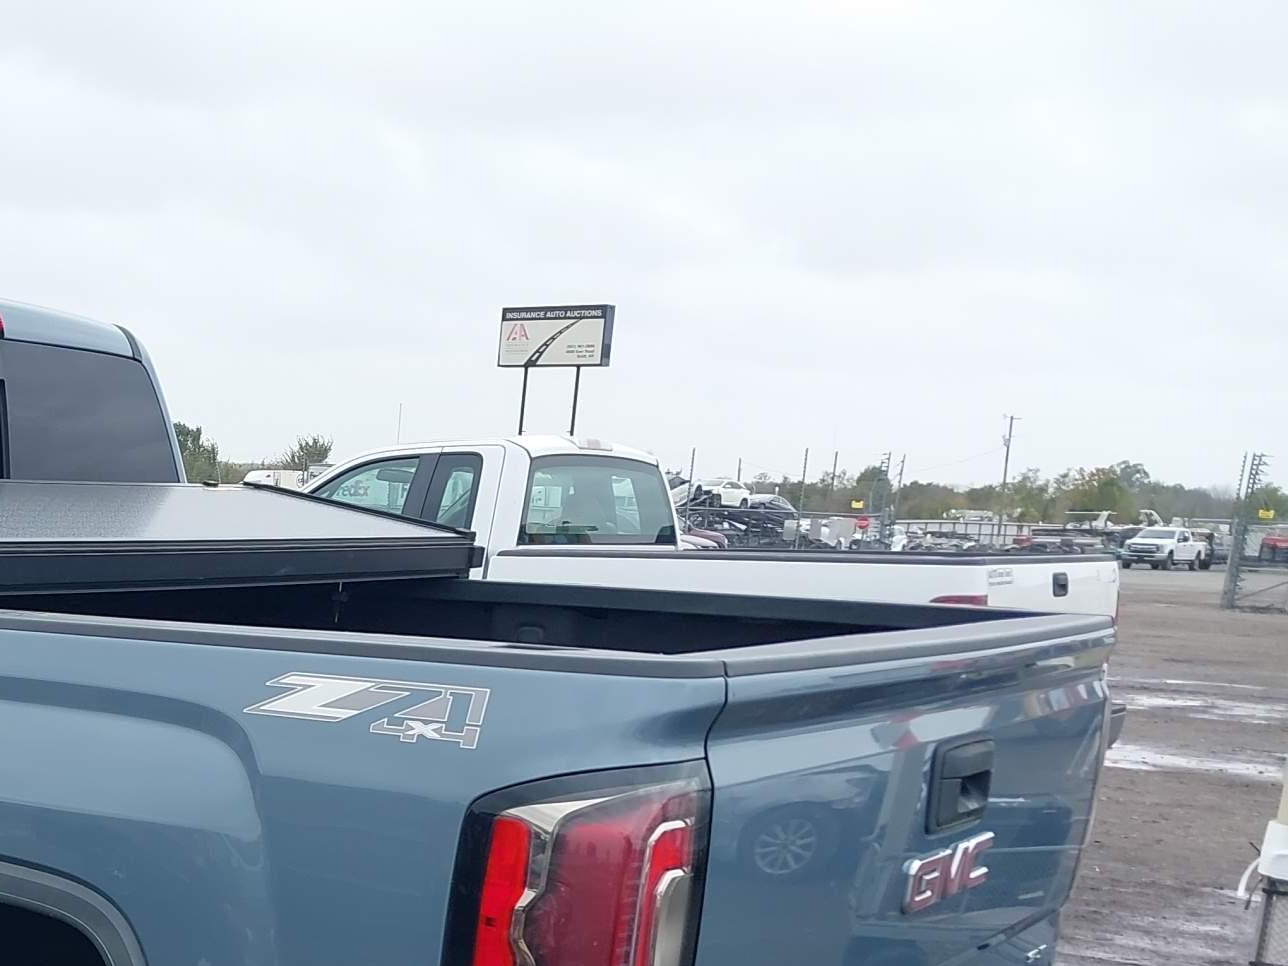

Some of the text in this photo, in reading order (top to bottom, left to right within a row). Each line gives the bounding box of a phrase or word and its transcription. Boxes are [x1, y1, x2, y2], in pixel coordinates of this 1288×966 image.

[506, 309, 602, 319] INSURANCE AUTO AUCTIONS
[243, 671, 491, 726] Z71
